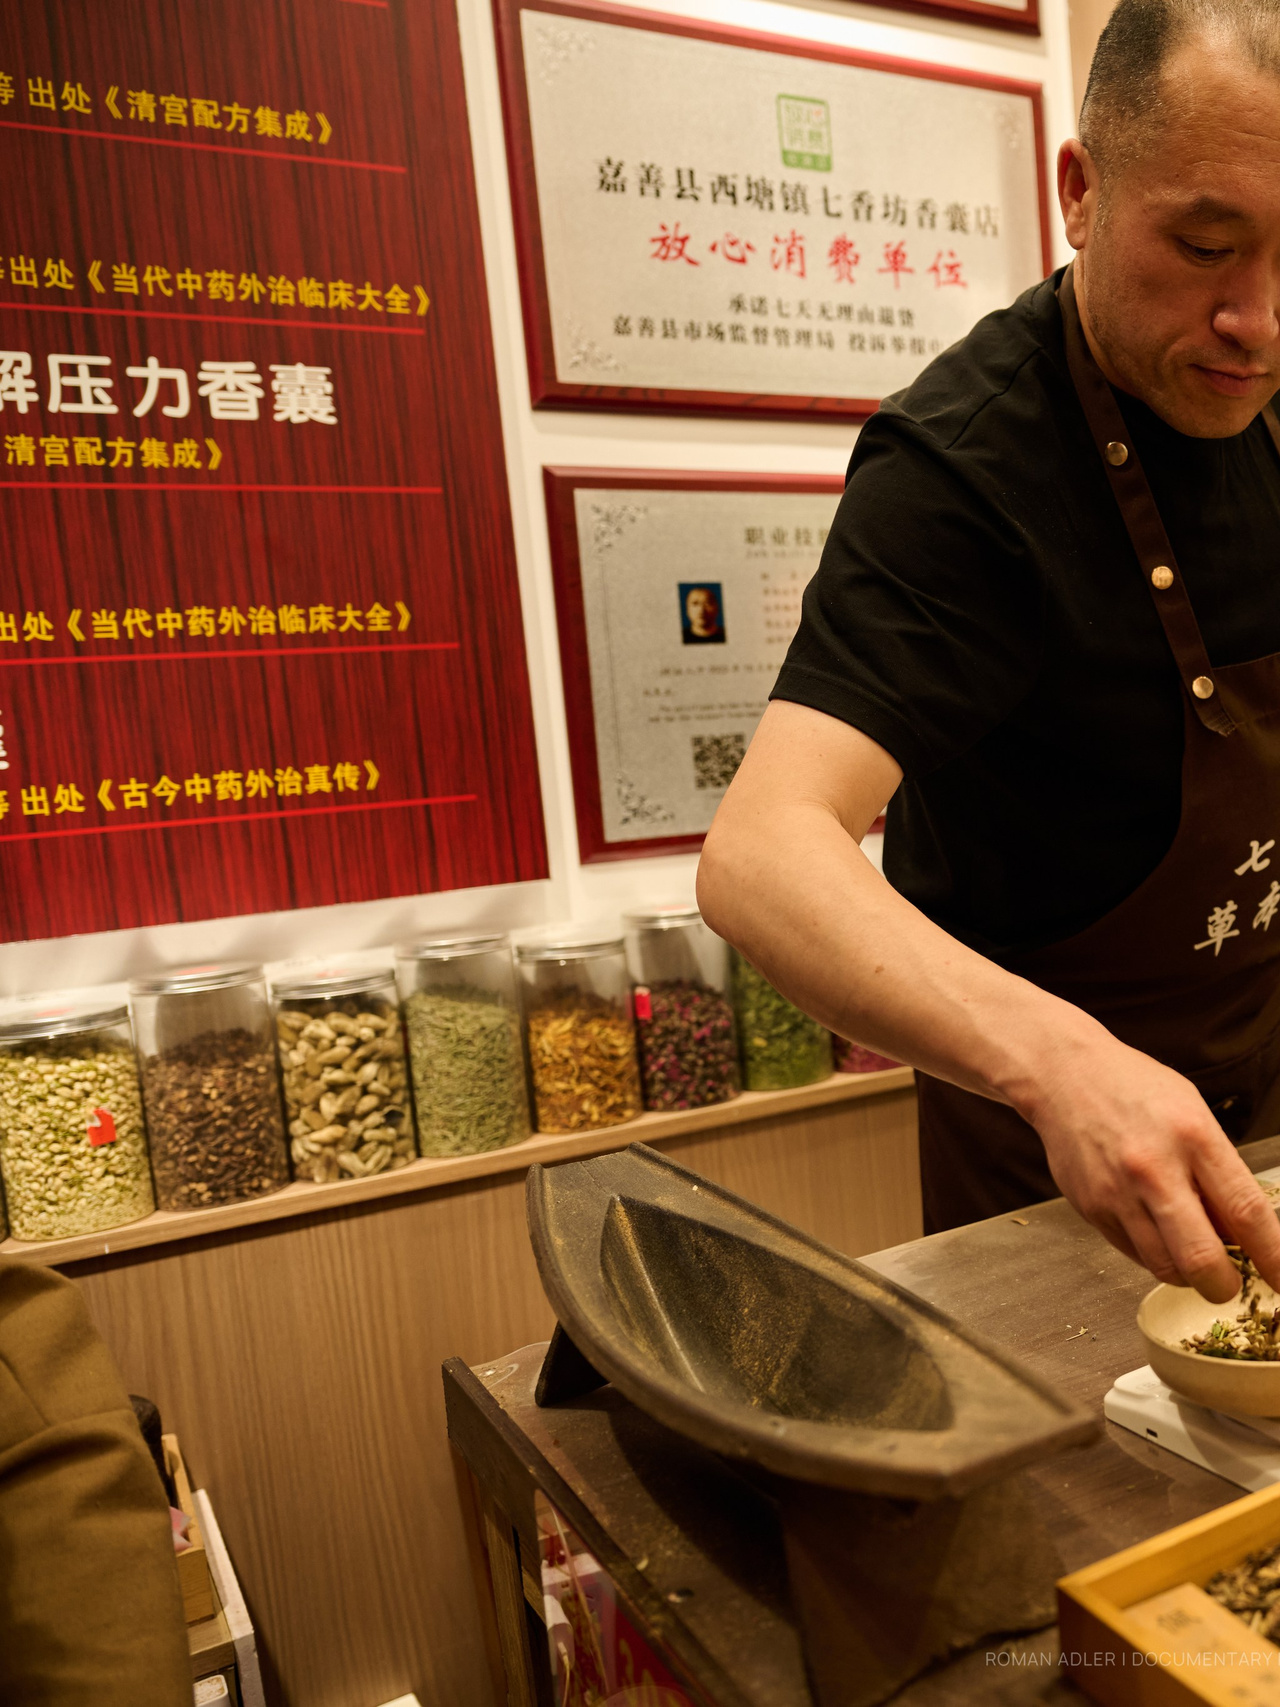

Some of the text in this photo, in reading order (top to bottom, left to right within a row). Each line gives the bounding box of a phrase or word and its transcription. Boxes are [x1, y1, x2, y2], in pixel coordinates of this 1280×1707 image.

[597, 158, 1000, 238] 嘉善县西塘镇七香坊香囊店
[0, 255, 430, 317] 出处《当代中药外治临床大全》
[649, 222, 968, 289] 放心消费单位
